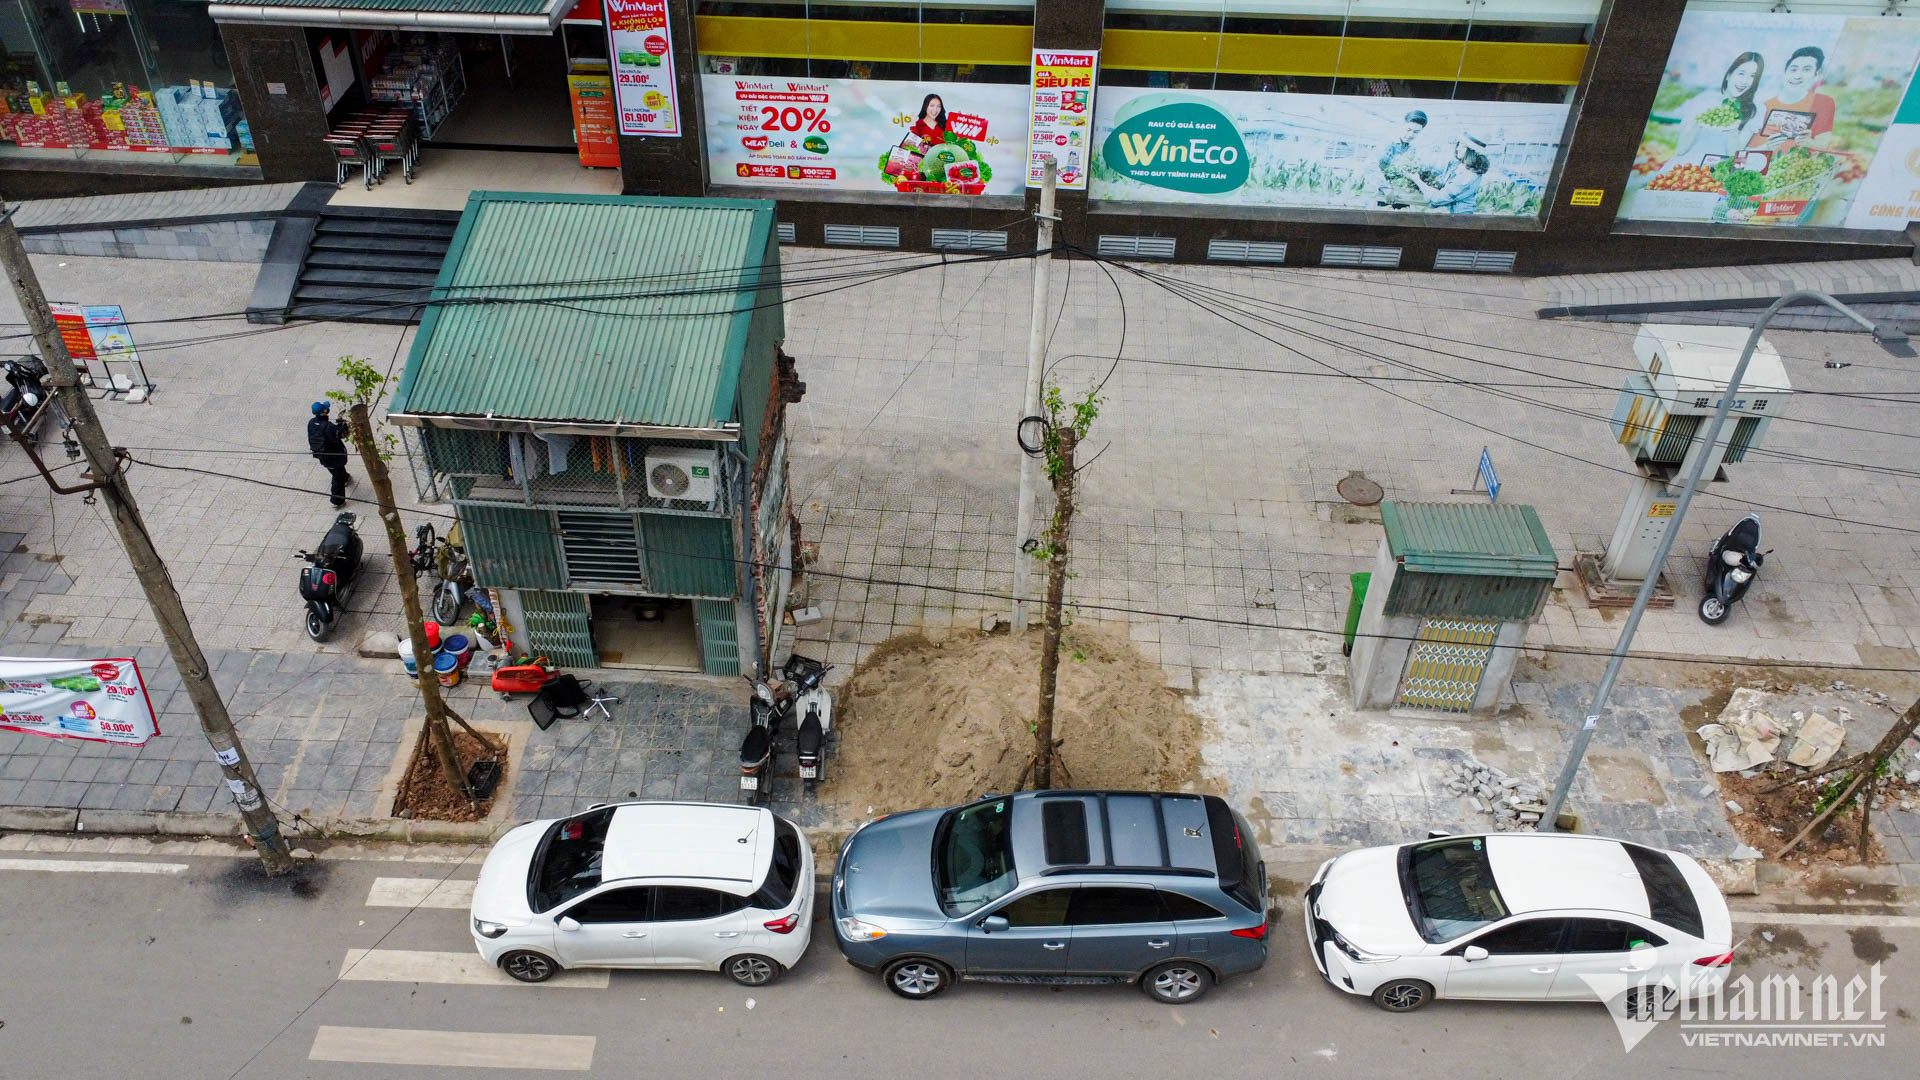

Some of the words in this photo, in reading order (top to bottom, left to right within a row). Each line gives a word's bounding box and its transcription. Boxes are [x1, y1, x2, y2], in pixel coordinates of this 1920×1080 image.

[608, 0, 664, 12] WinMart
[1040, 54, 1090, 66] WinMart
[735, 81, 774, 90] WinMart
[1036, 76, 1068, 87] SIÊU
[1071, 74, 1090, 87] RẺ
[761, 106, 831, 133] 20%
[1165, 120, 1176, 128] CỦ
[1177, 121, 1194, 129] QUẢ
[745, 139, 767, 147] MEAT
[790, 140, 798, 149] &
[1118, 132, 1238, 166] WinEco
[1168, 170, 1189, 178] TRÌNH
[1190, 171, 1209, 179] NHẬT
[1210, 171, 1227, 179] BẢN
